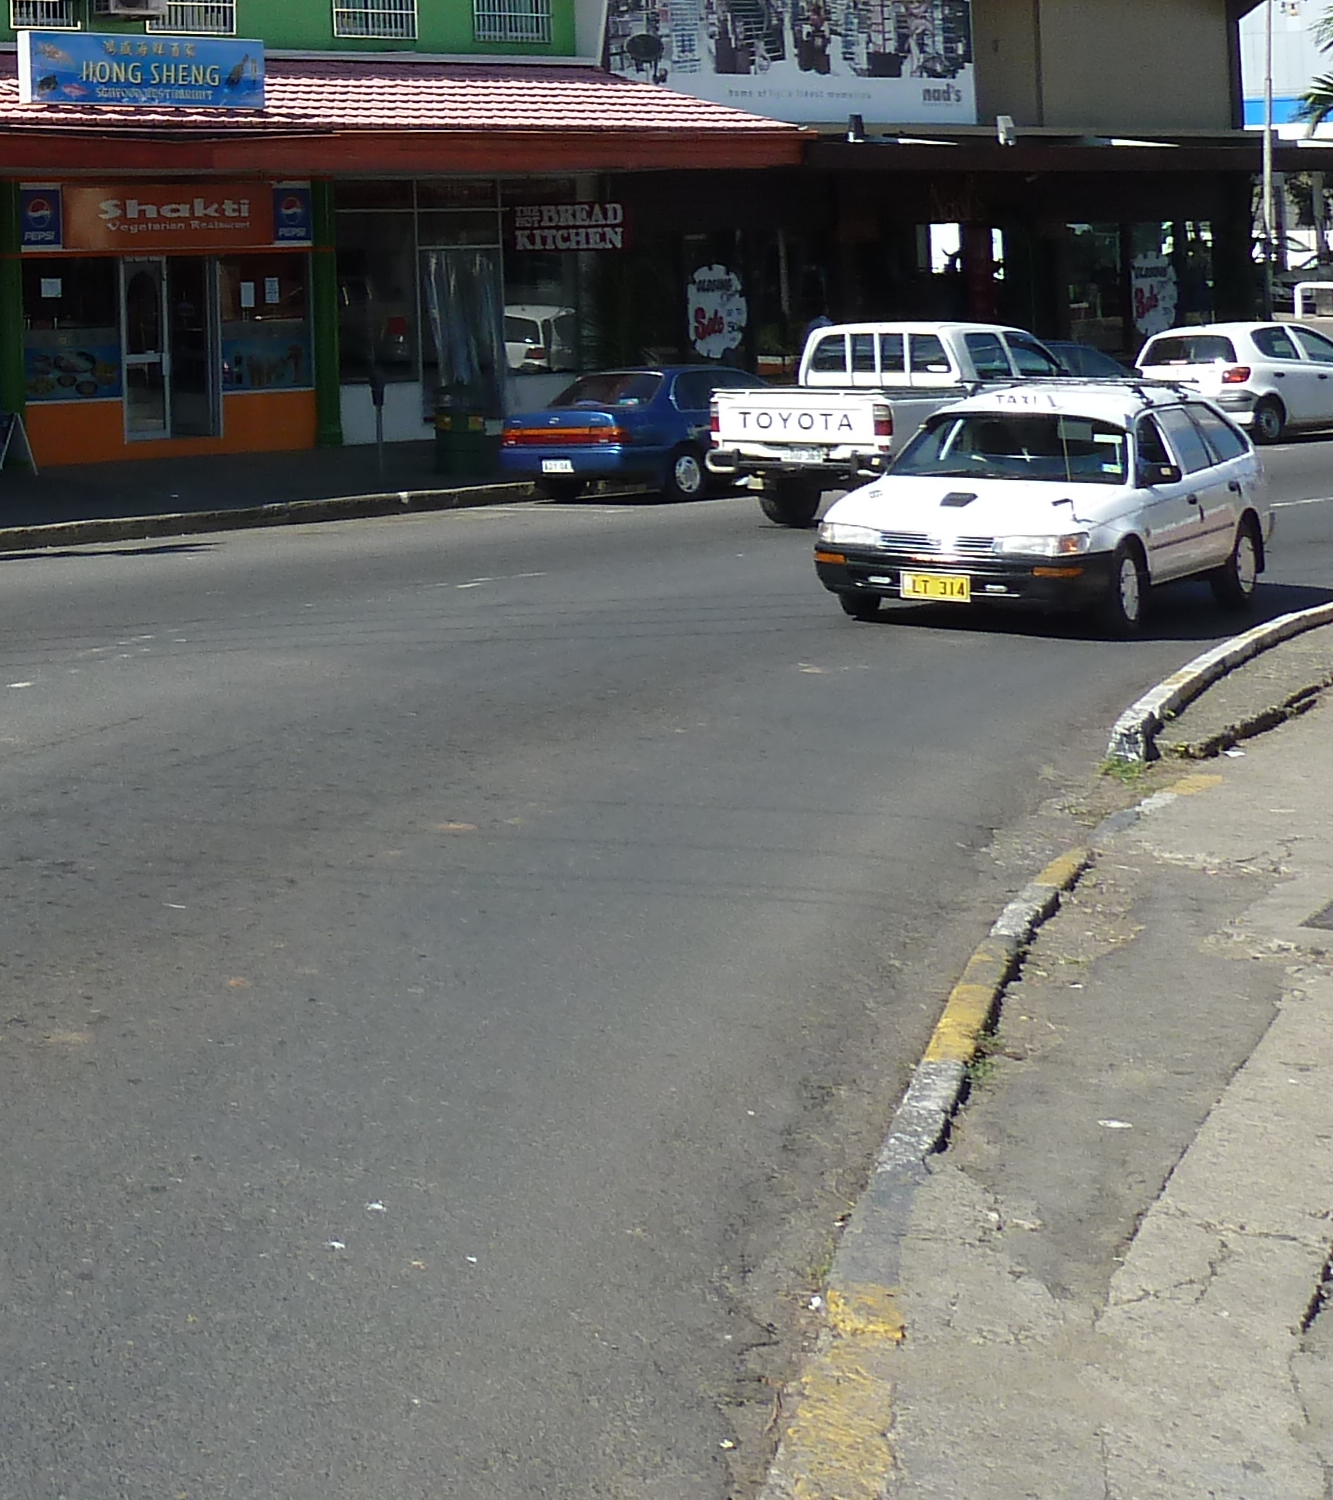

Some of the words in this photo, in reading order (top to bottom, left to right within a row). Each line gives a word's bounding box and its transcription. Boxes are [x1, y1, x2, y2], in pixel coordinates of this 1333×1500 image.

[82, 60, 142, 84] HONG
[150, 62, 221, 86] SHENG
[922, 83, 962, 103] nad's
[98, 198, 250, 220] Shakti
[541, 202, 624, 226] BREAD
[24, 231, 56, 241] PEPSI
[106, 219, 185, 234] Vegetarian
[190, 219, 250, 230] Restaurant
[278, 227, 307, 237] PEPSI
[515, 227, 624, 250] KITCHEN
[995, 394, 1037, 405] TAXI
[738, 411, 853, 431] TOYOTA
[912, 579, 930, 594] LT
[939, 581, 965, 596] 314
